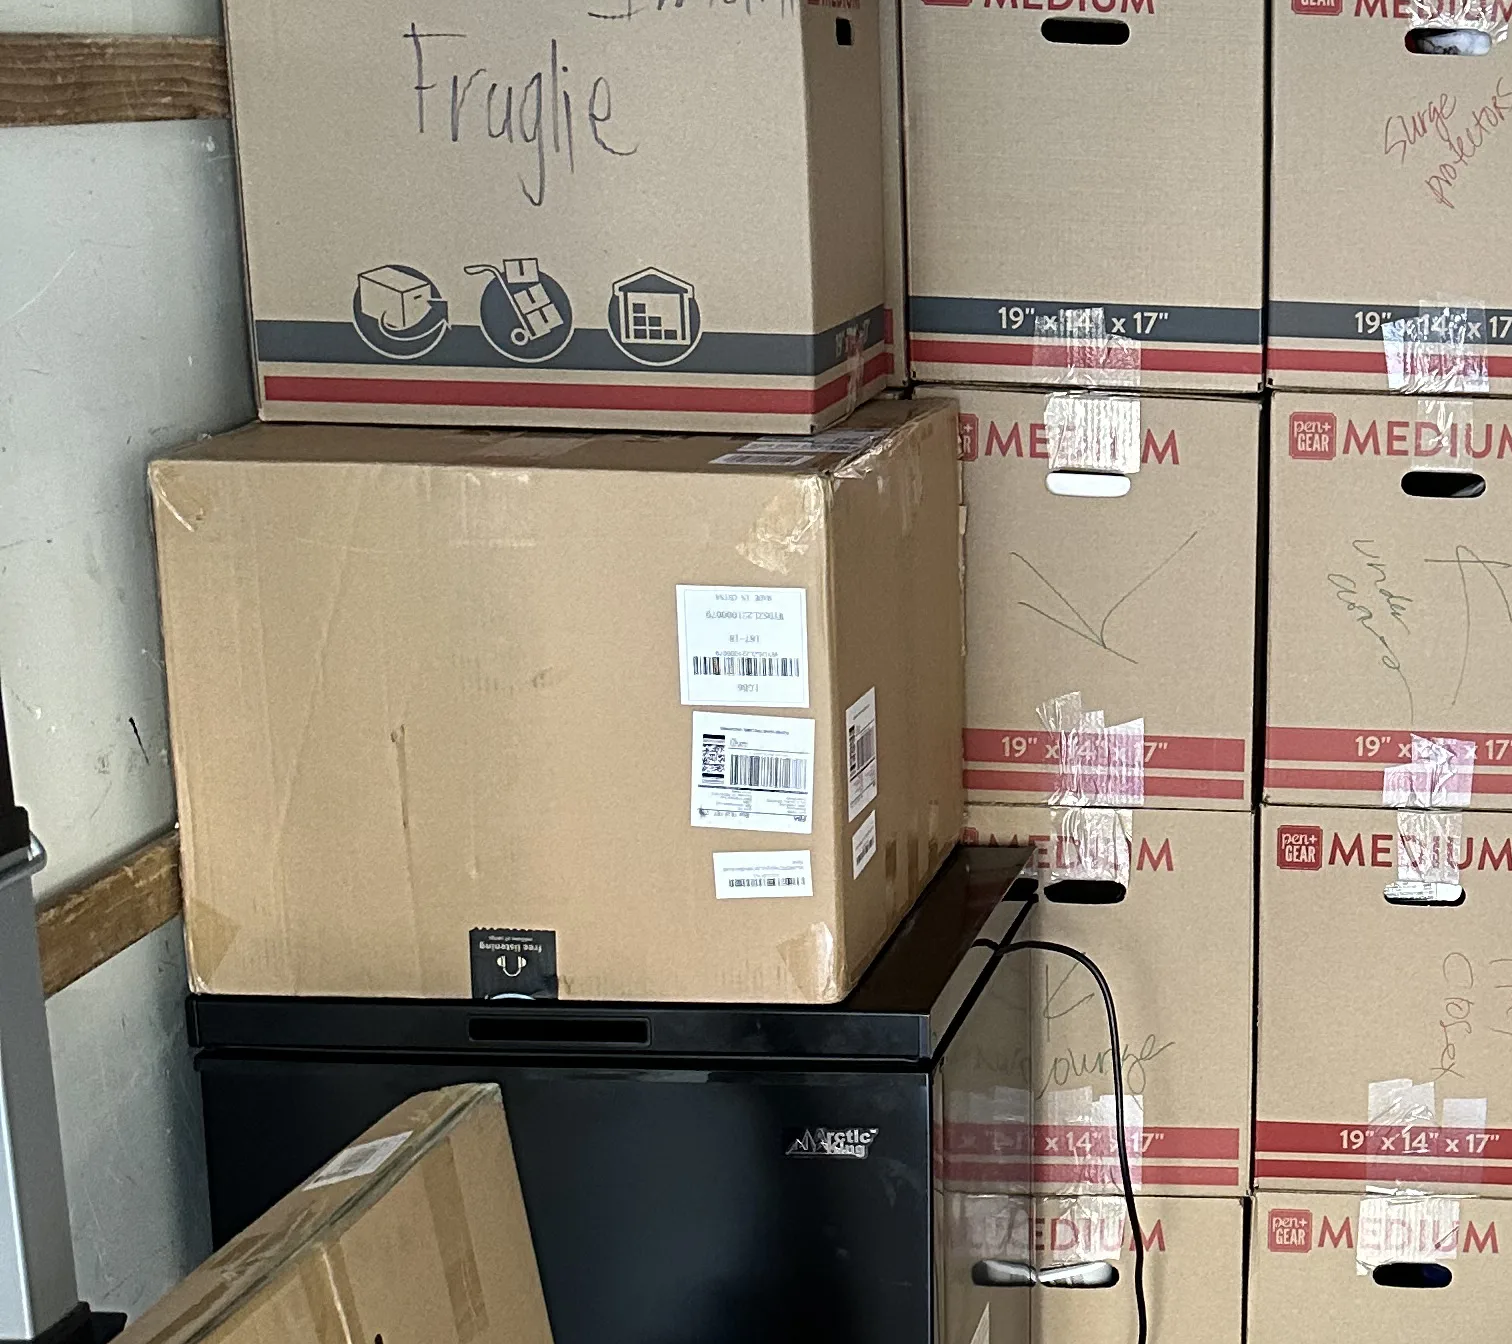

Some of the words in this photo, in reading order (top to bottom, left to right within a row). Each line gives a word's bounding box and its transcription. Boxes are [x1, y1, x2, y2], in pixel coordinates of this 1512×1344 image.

[479, 941, 521, 953] listening
[1036, 1218, 1166, 1252] EDIUM
[1318, 1215, 1499, 1254] MEDIUM
